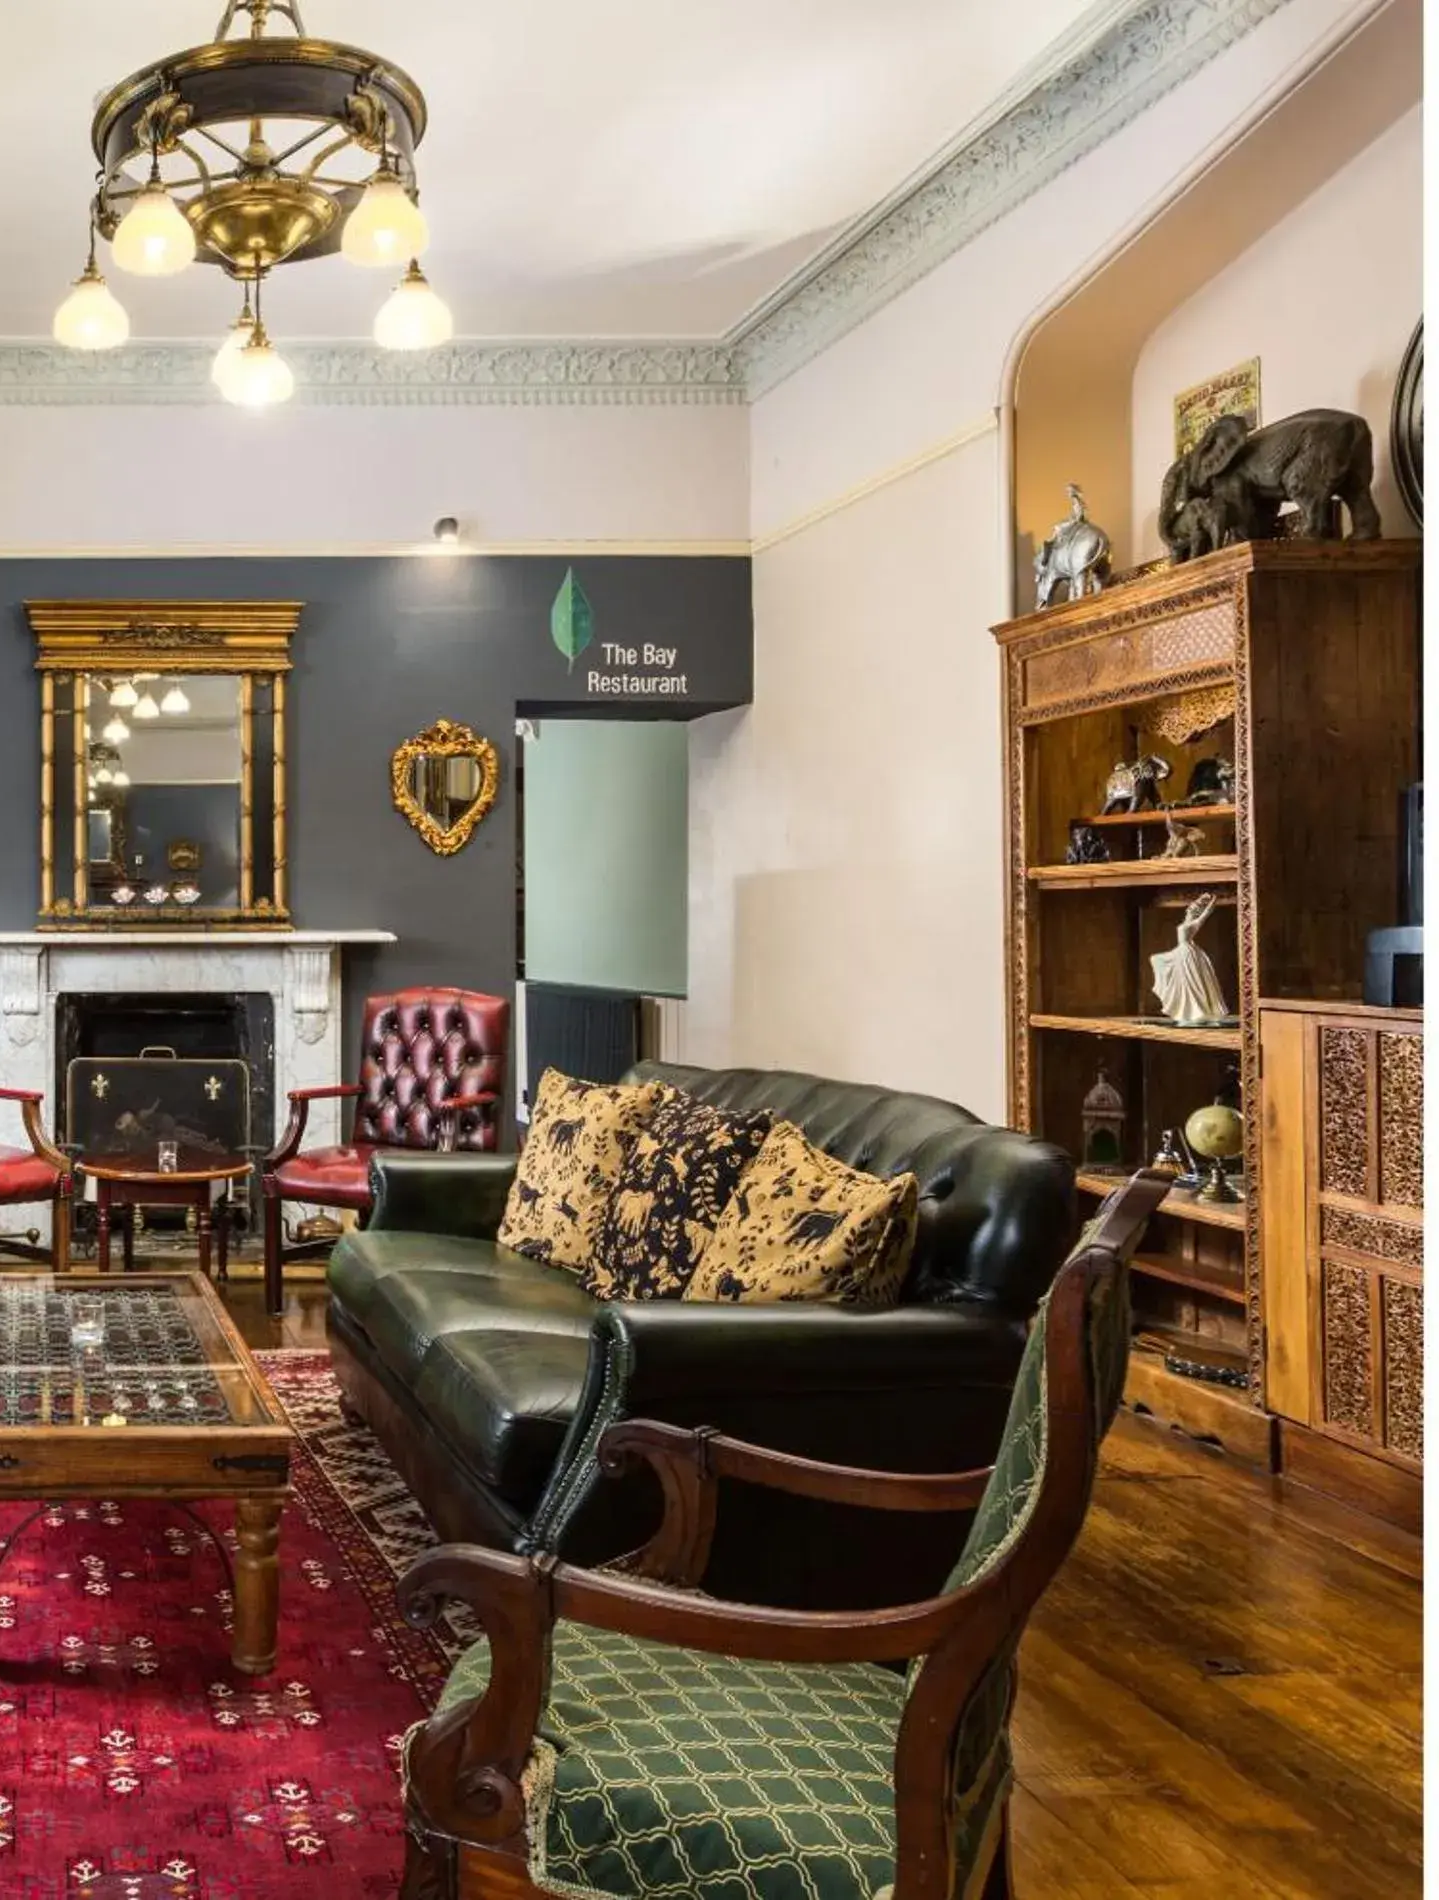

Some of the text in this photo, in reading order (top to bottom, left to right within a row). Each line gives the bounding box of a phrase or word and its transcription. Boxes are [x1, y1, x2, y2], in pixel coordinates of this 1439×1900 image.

[602, 643, 677, 668] The Bay
[588, 671, 688, 693] Restaurant
